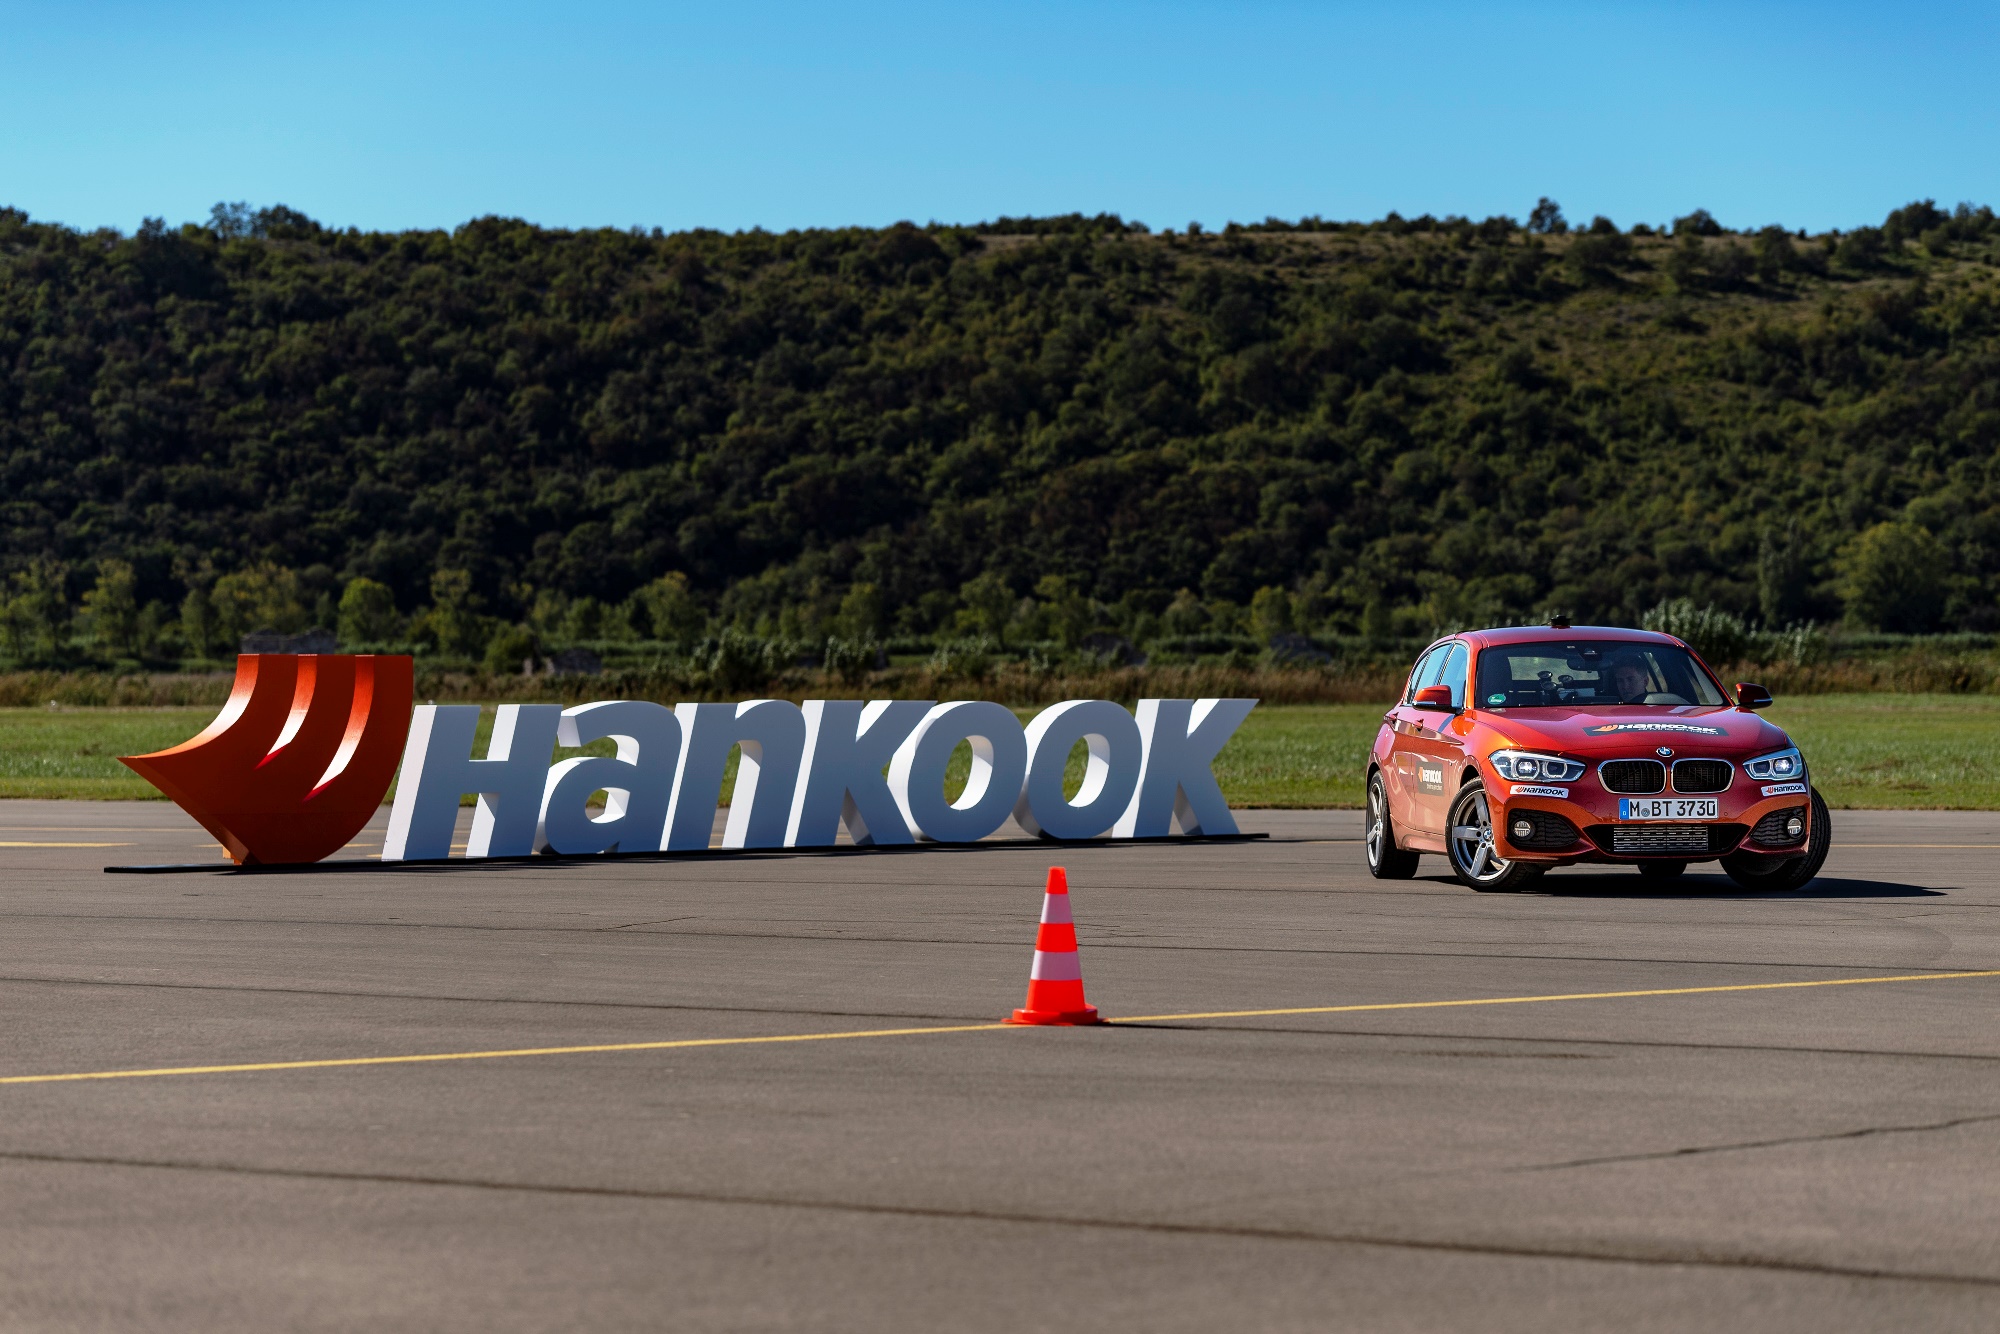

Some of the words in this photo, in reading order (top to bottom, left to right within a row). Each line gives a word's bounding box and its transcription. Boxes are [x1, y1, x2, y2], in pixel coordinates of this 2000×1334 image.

[1629, 801, 1640, 816] M
[1651, 801, 1672, 816] BT
[1677, 801, 1716, 816] 3730
